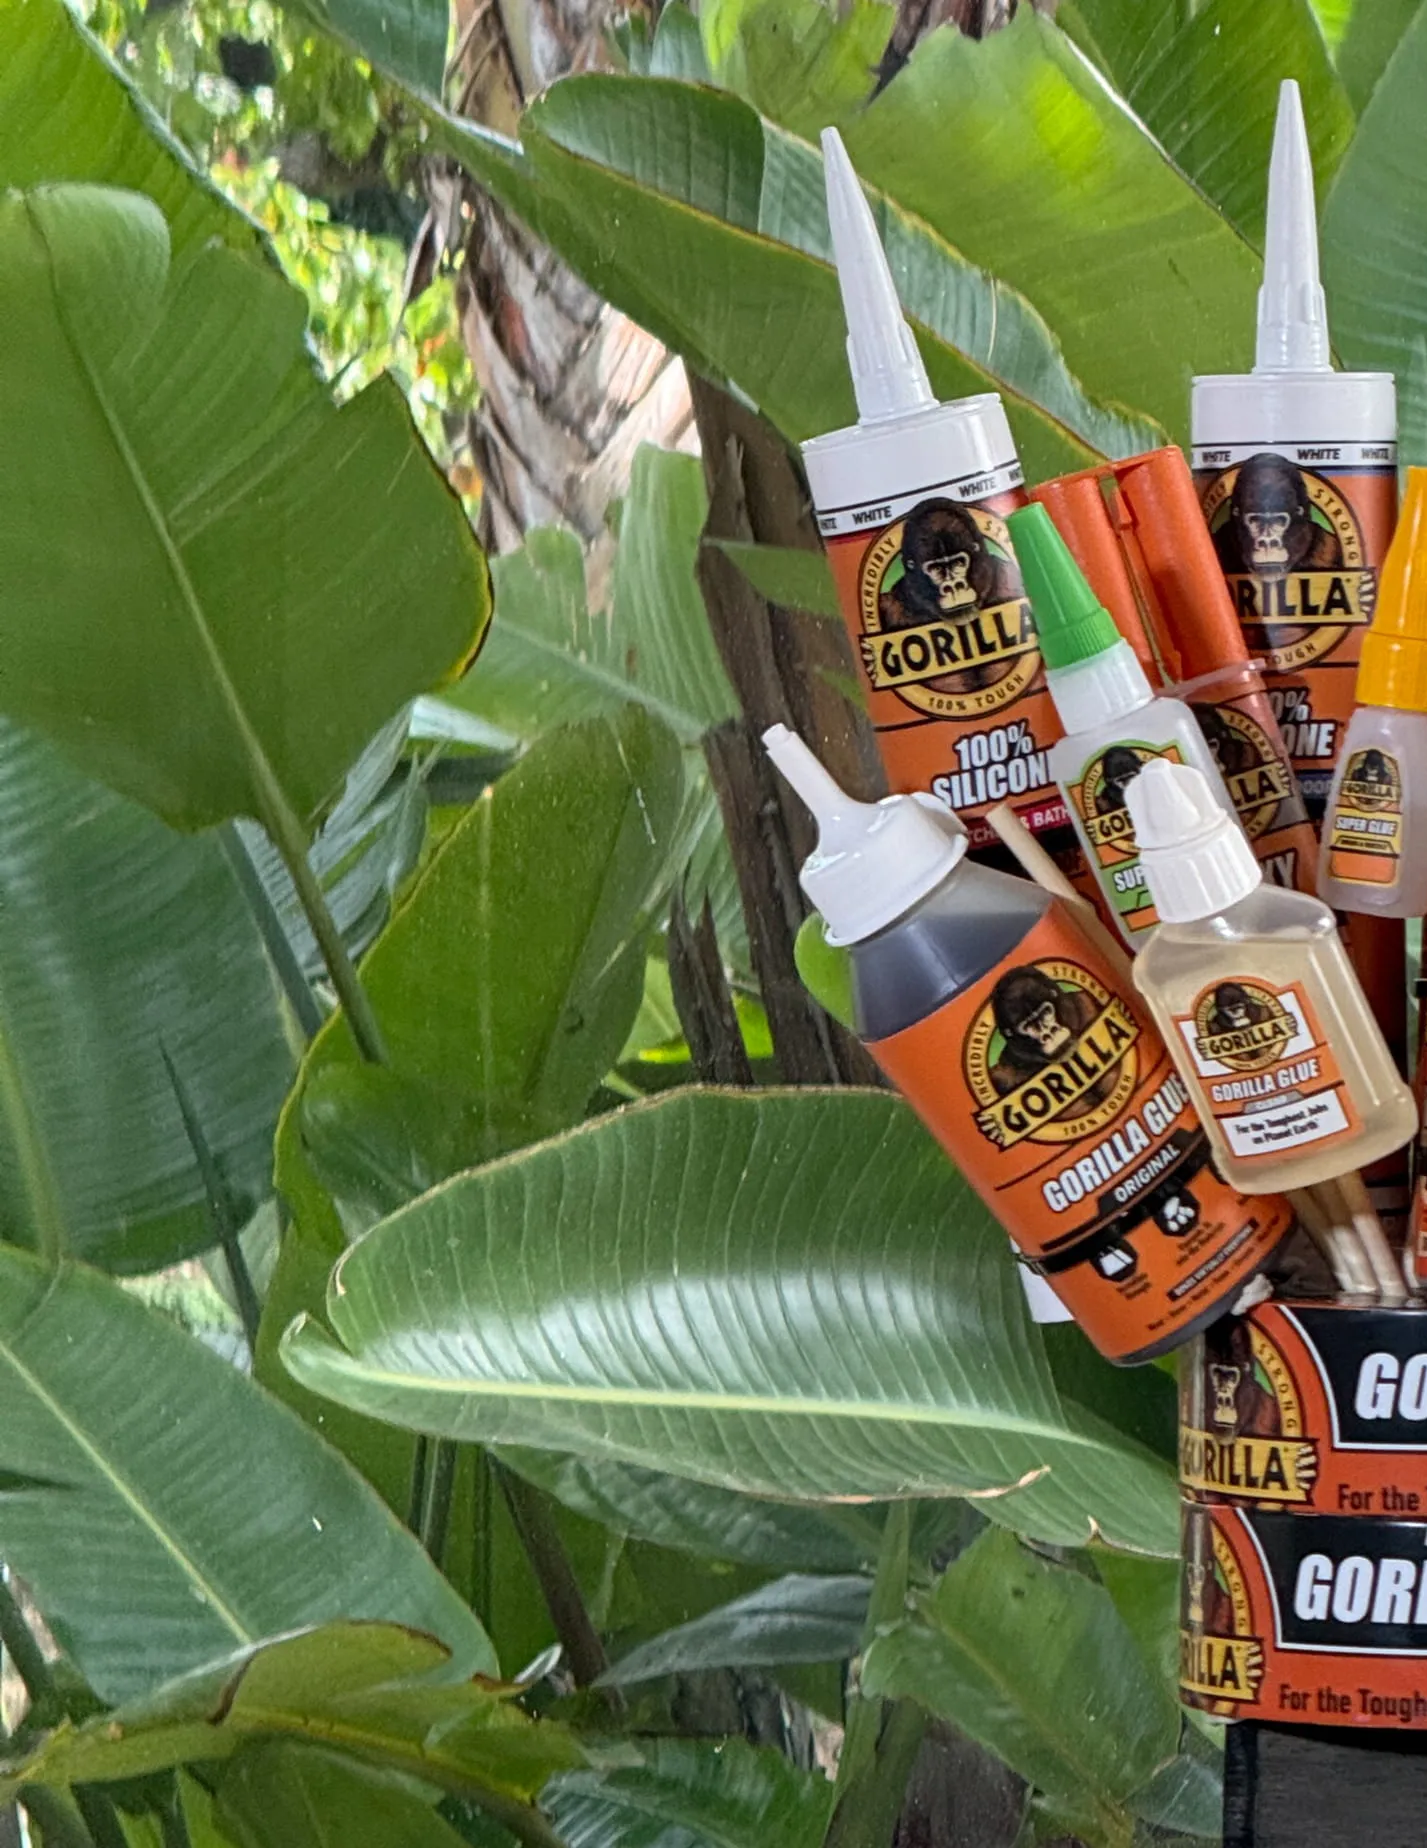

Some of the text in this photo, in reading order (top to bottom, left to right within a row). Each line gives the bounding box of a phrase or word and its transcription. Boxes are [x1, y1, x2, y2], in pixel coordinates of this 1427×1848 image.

[1202, 448, 1390, 463] WHITE WHITE WHITE
[852, 505, 892, 525] WHITE
[959, 477, 996, 498] WHITE
[1314, 488, 1359, 561] STRONG
[866, 540, 897, 628] INCREDIBLY
[1236, 577, 1353, 617] RILLA
[880, 602, 1036, 678] GORILLA
[928, 675, 1025, 712] 100% TOUGH
[954, 721, 1033, 771] 100%
[932, 751, 1050, 810] SILICON
[1336, 816, 1397, 836] SUPER GLUE
[1051, 964, 1106, 1000] STRONG
[969, 1020, 992, 1101] INCREDIBLY
[1209, 1021, 1287, 1055] GORILLA
[1002, 1015, 1131, 1134] GORILLA
[1211, 1073, 1277, 1103] GORILLA
[1277, 1059, 1320, 1088] GLUE
[1063, 1073, 1132, 1136] 100% TOUGH
[1042, 1117, 1150, 1213] GORILLA
[1113, 1143, 1182, 1204] ORIGINAL
[1257, 1343, 1298, 1430] STRONG
[1337, 1484, 1375, 1511] For
[1381, 1485, 1418, 1511] the
[1278, 1683, 1315, 1710] For
[1316, 1683, 1353, 1713] the
